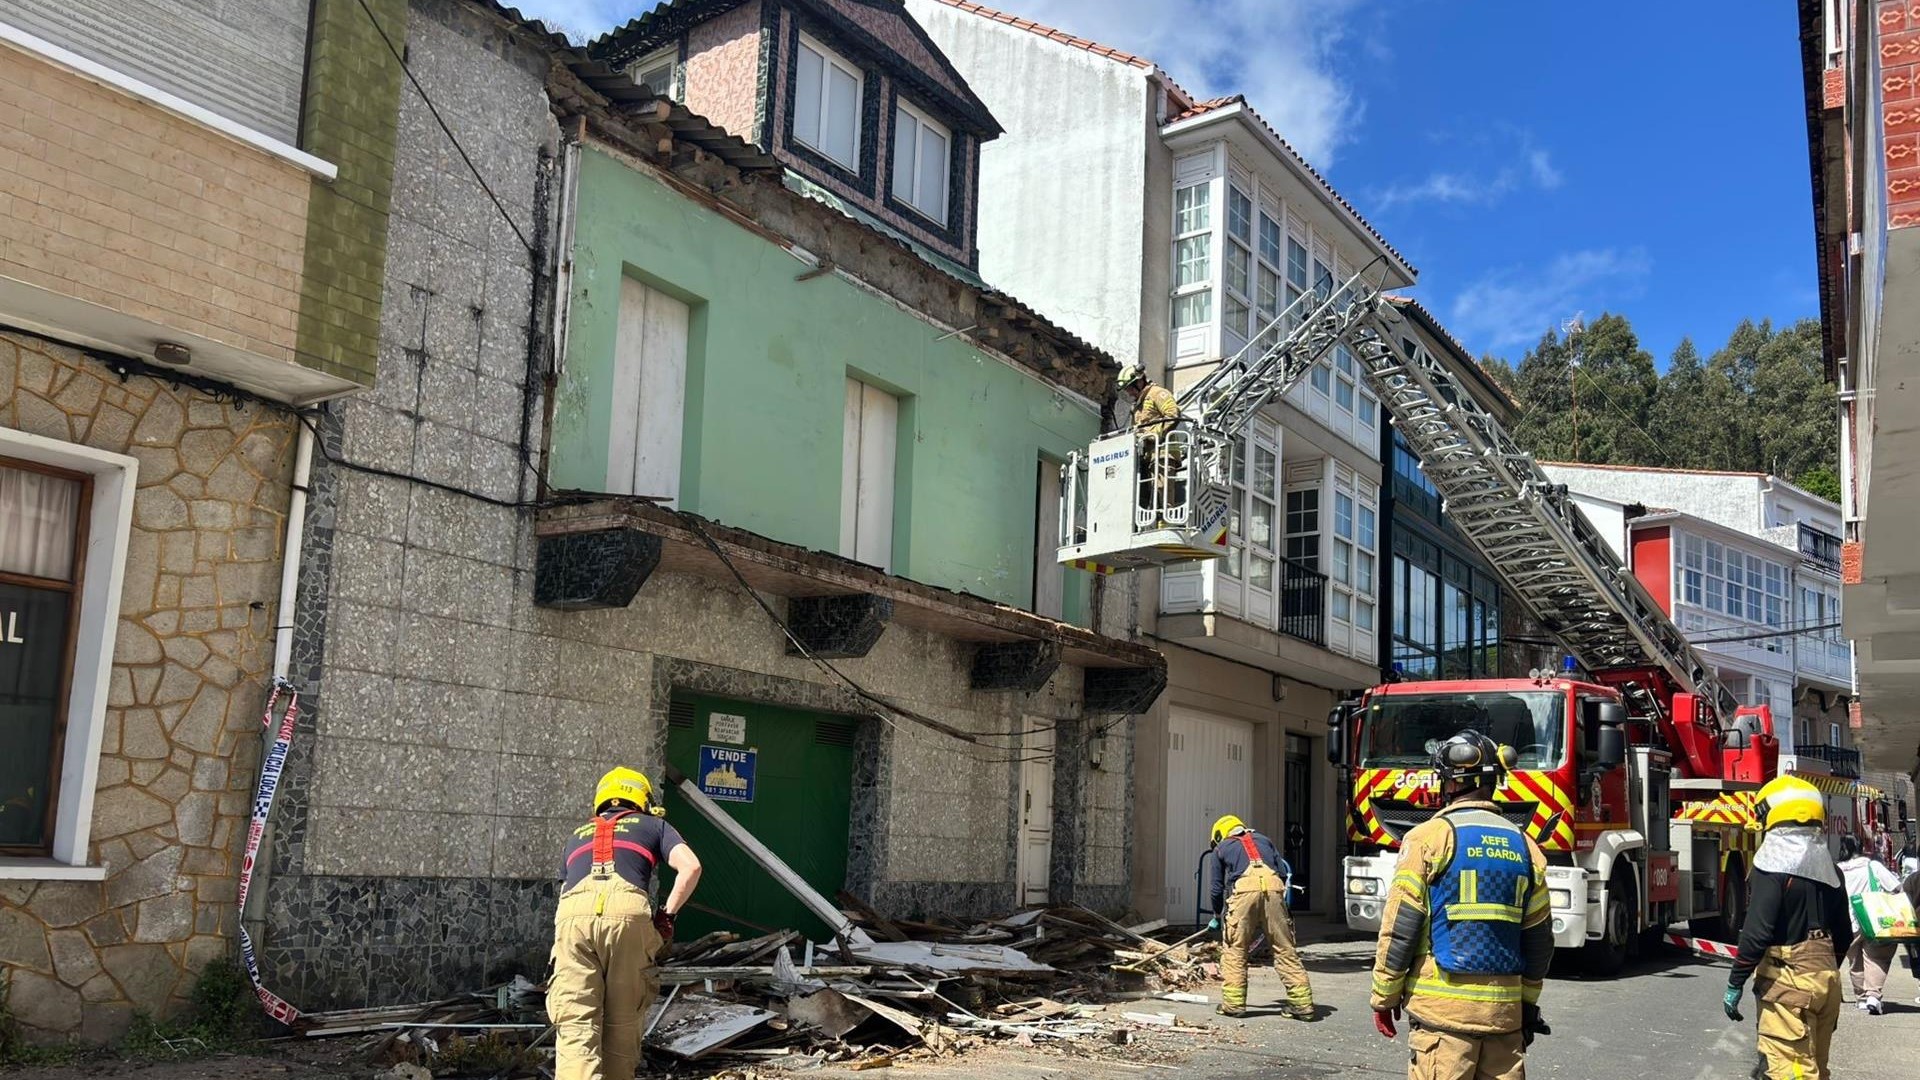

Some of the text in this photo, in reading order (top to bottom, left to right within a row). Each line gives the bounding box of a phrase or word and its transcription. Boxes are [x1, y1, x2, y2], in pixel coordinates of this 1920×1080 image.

[1093, 449, 1130, 465] MAGIRUS
[1201, 502, 1228, 534] MAGIRUS
[0, 611, 23, 644] L
[264, 741, 288, 773] POLICIA
[711, 749, 747, 763] VENDE
[257, 775, 278, 801] LOCAL
[1481, 834, 1509, 847] XEFE
[1467, 847, 1523, 863] DE GARDA
